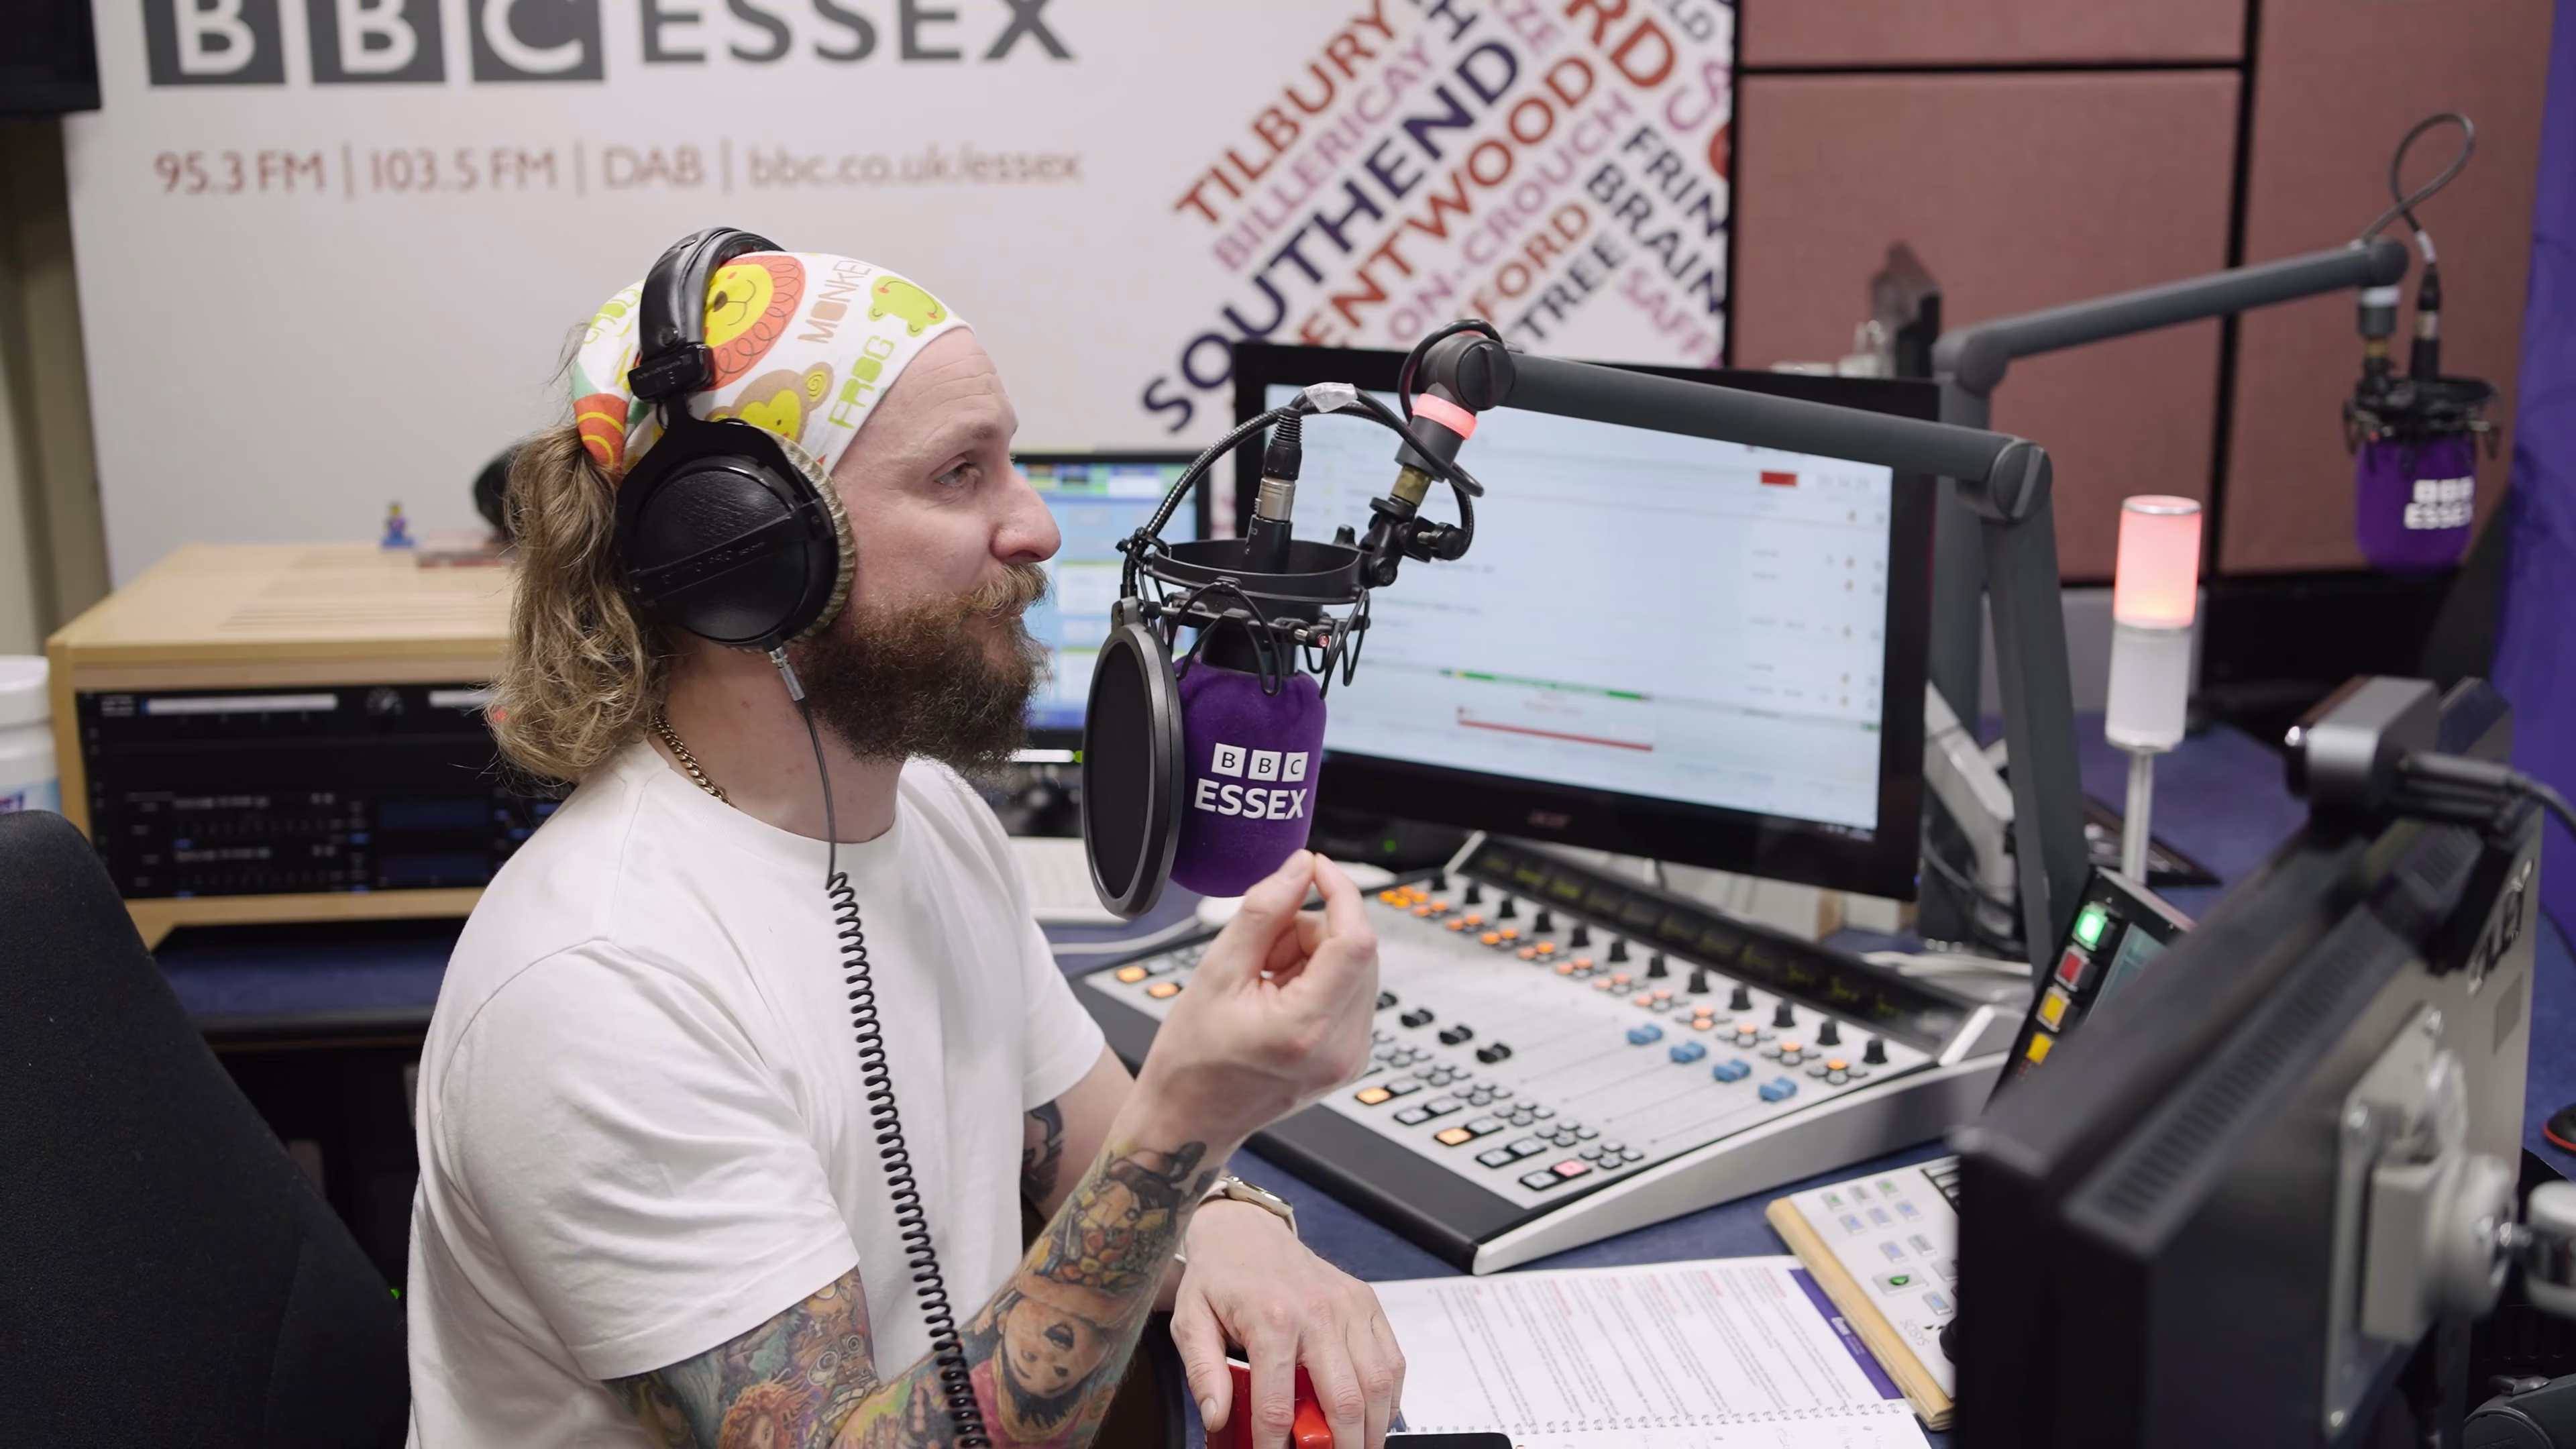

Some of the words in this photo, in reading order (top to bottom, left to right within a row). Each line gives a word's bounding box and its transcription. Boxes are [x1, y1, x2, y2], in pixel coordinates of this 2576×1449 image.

[168, 0, 589, 76] BBC
[639, 0, 1079, 64] ESSEX
[1174, 0, 1395, 223] TILBURY
[1213, 37, 1433, 271] BILLERICAY
[155, 151, 244, 193] 95.3
[258, 152, 325, 193] FM
[371, 150, 479, 192] 103.5
[491, 149, 555, 189] FM
[601, 146, 705, 189] DAB
[748, 145, 1083, 192] bbc.co.uk/essex
[1142, 42, 1517, 434] SOUTHEND
[1453, 203, 1589, 323] FORD
[826, 335, 895, 429] FROG
[1194, 777, 1307, 820] ESSEX
[1217, 748, 1306, 778] BBC
